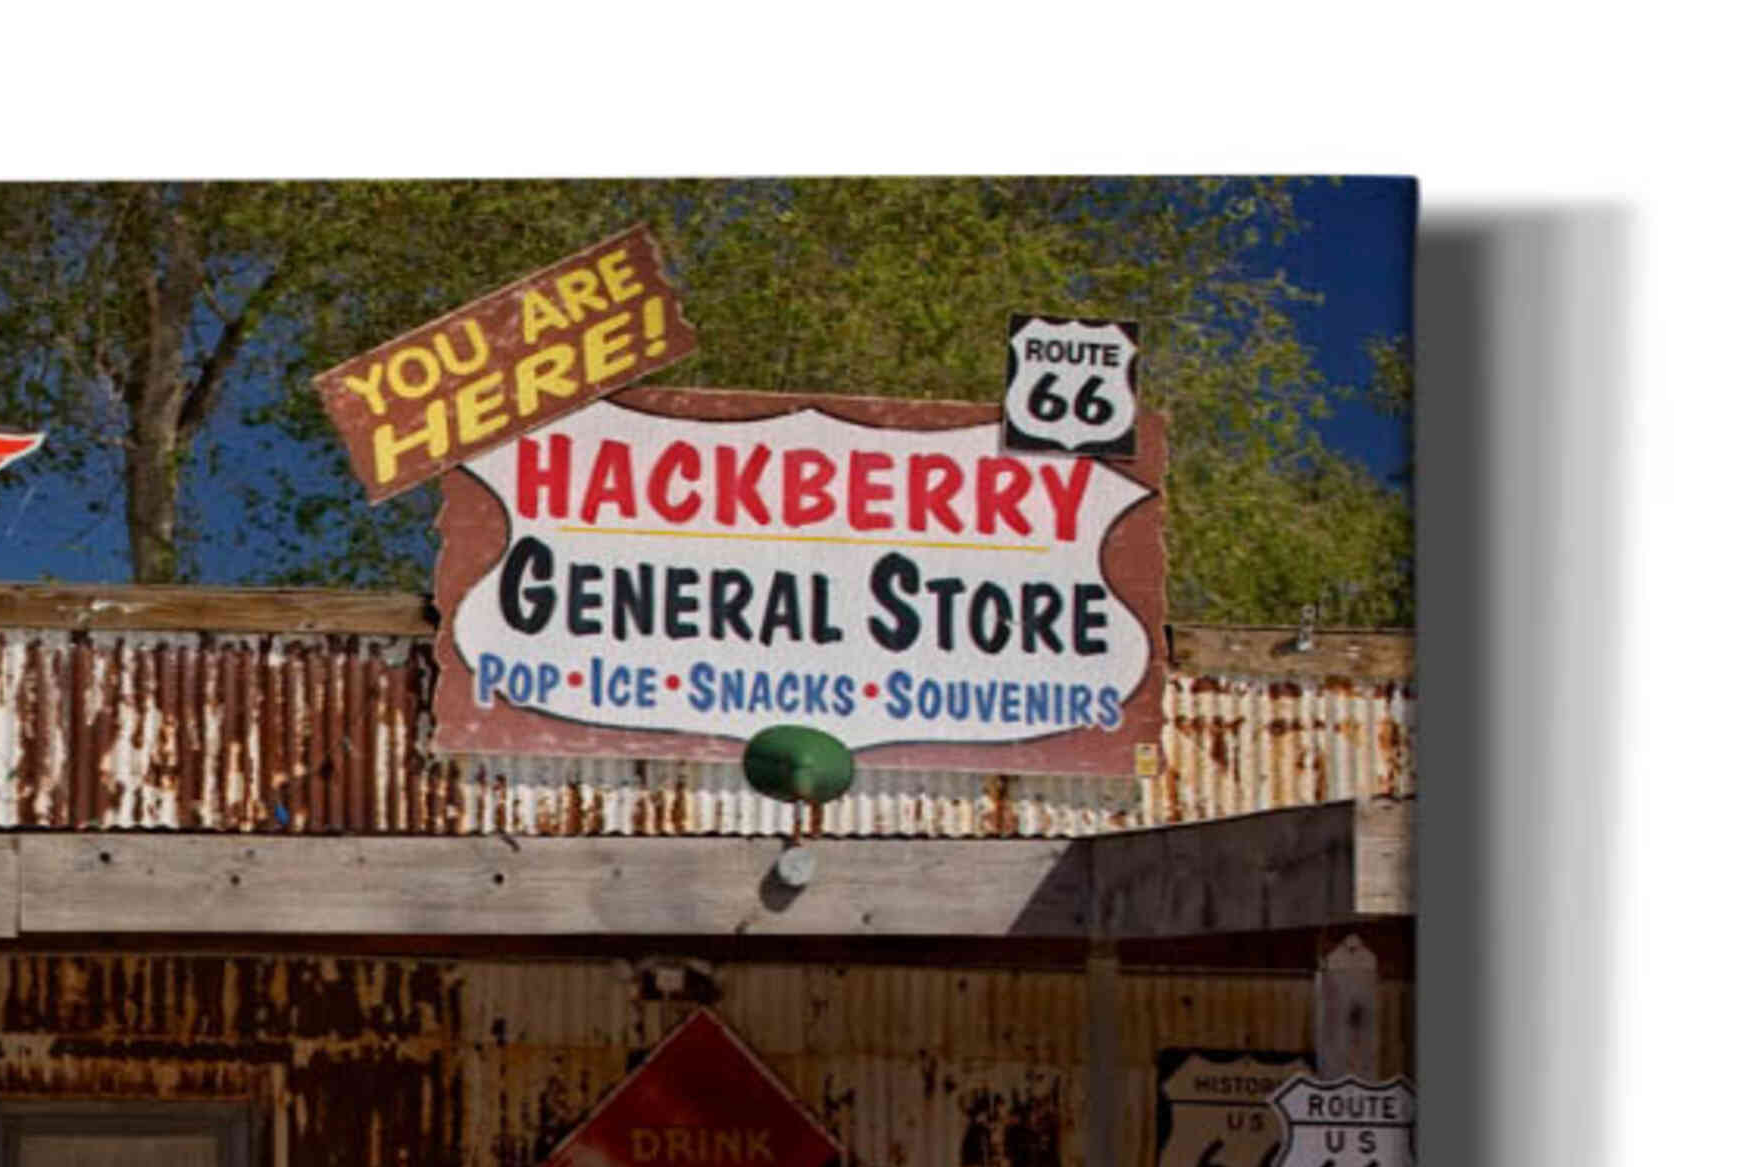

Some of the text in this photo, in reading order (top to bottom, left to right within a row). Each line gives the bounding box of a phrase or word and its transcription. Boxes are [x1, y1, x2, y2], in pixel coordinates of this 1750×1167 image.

[347, 249, 644, 415] YOU ARE
[1025, 338, 1121, 369] ROUTE
[373, 296, 669, 485] HERE!
[1026, 374, 1116, 426] 66
[515, 433, 1095, 543] HACKBERRY
[499, 536, 1110, 656] GENERAL STORE
[477, 653, 1124, 729] POP ICE SNACKS SOUVENIRS
[1194, 1075, 1282, 1095] HISTOR
[1308, 1095, 1398, 1119] ROUTE
[630, 1127, 775, 1165] DRINK
[1325, 1130, 1377, 1153] US
